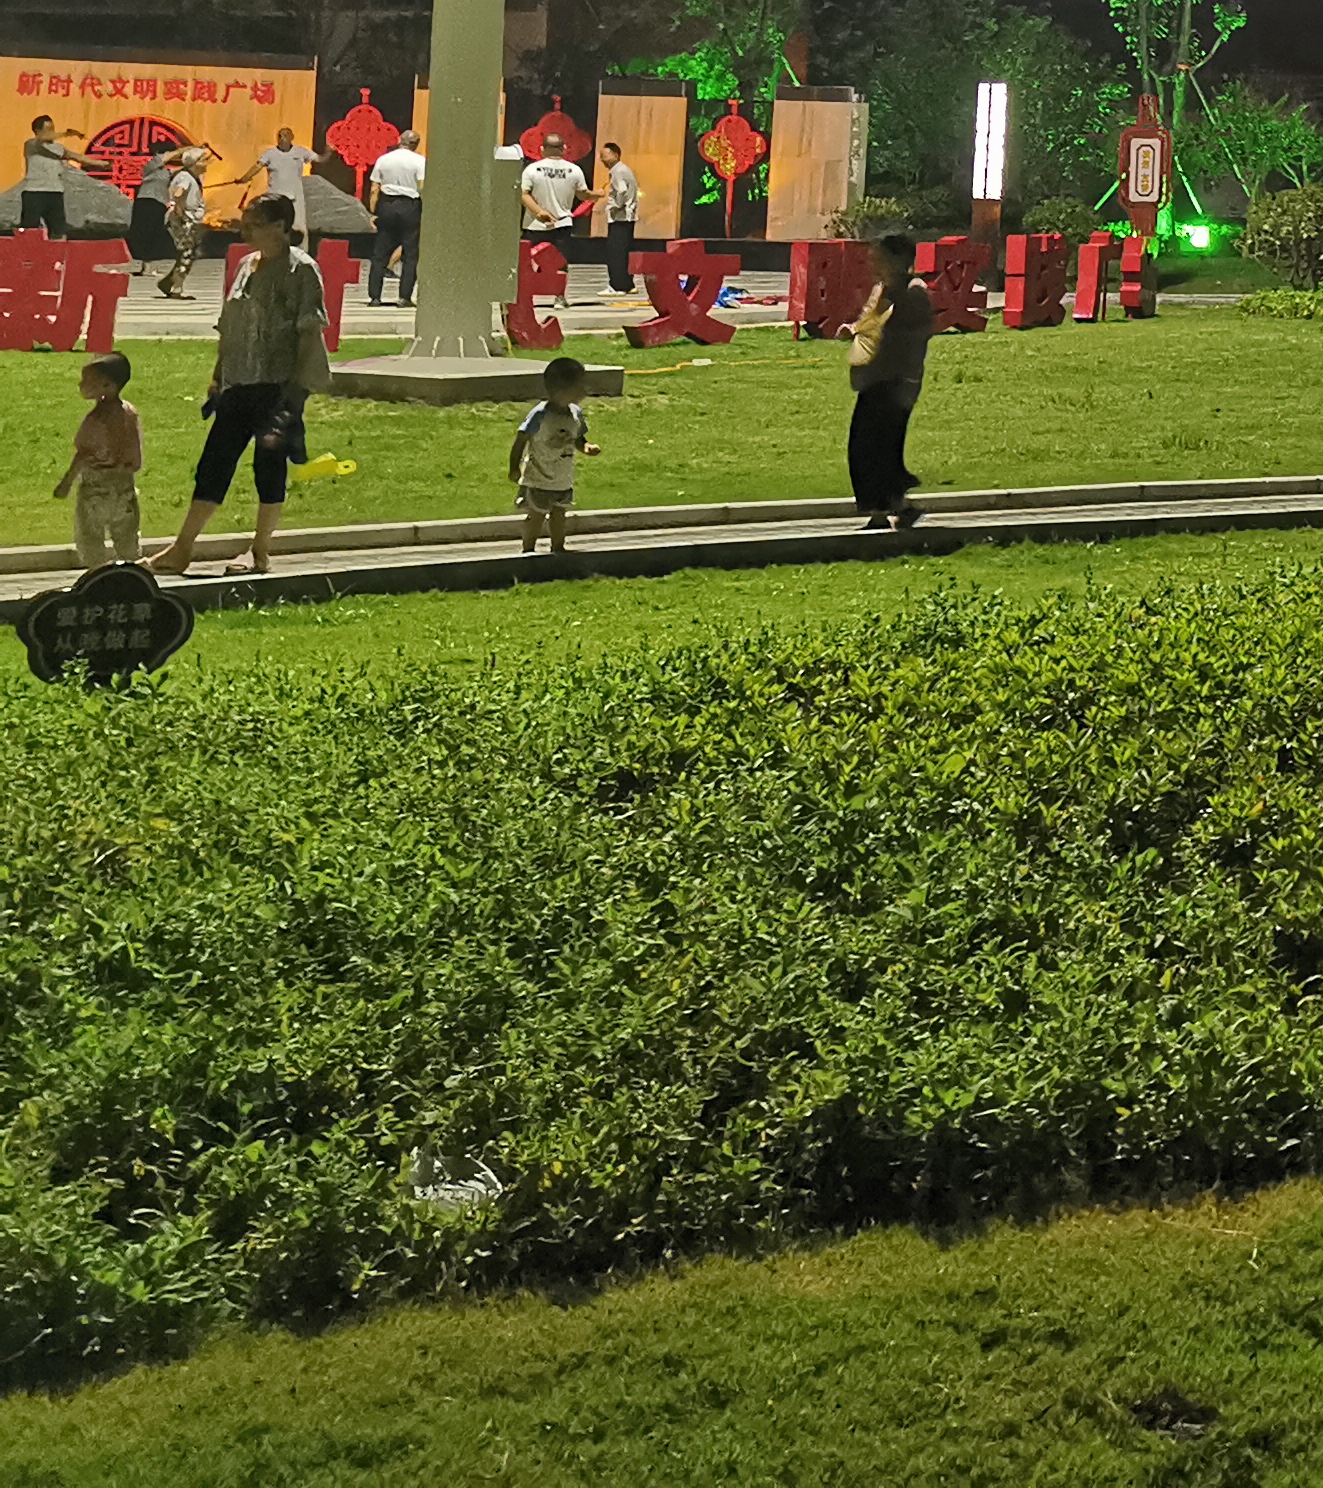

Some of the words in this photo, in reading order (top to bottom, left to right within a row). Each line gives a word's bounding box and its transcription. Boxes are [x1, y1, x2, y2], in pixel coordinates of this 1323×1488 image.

[16, 71, 276, 105] 新时代文明实践广场
